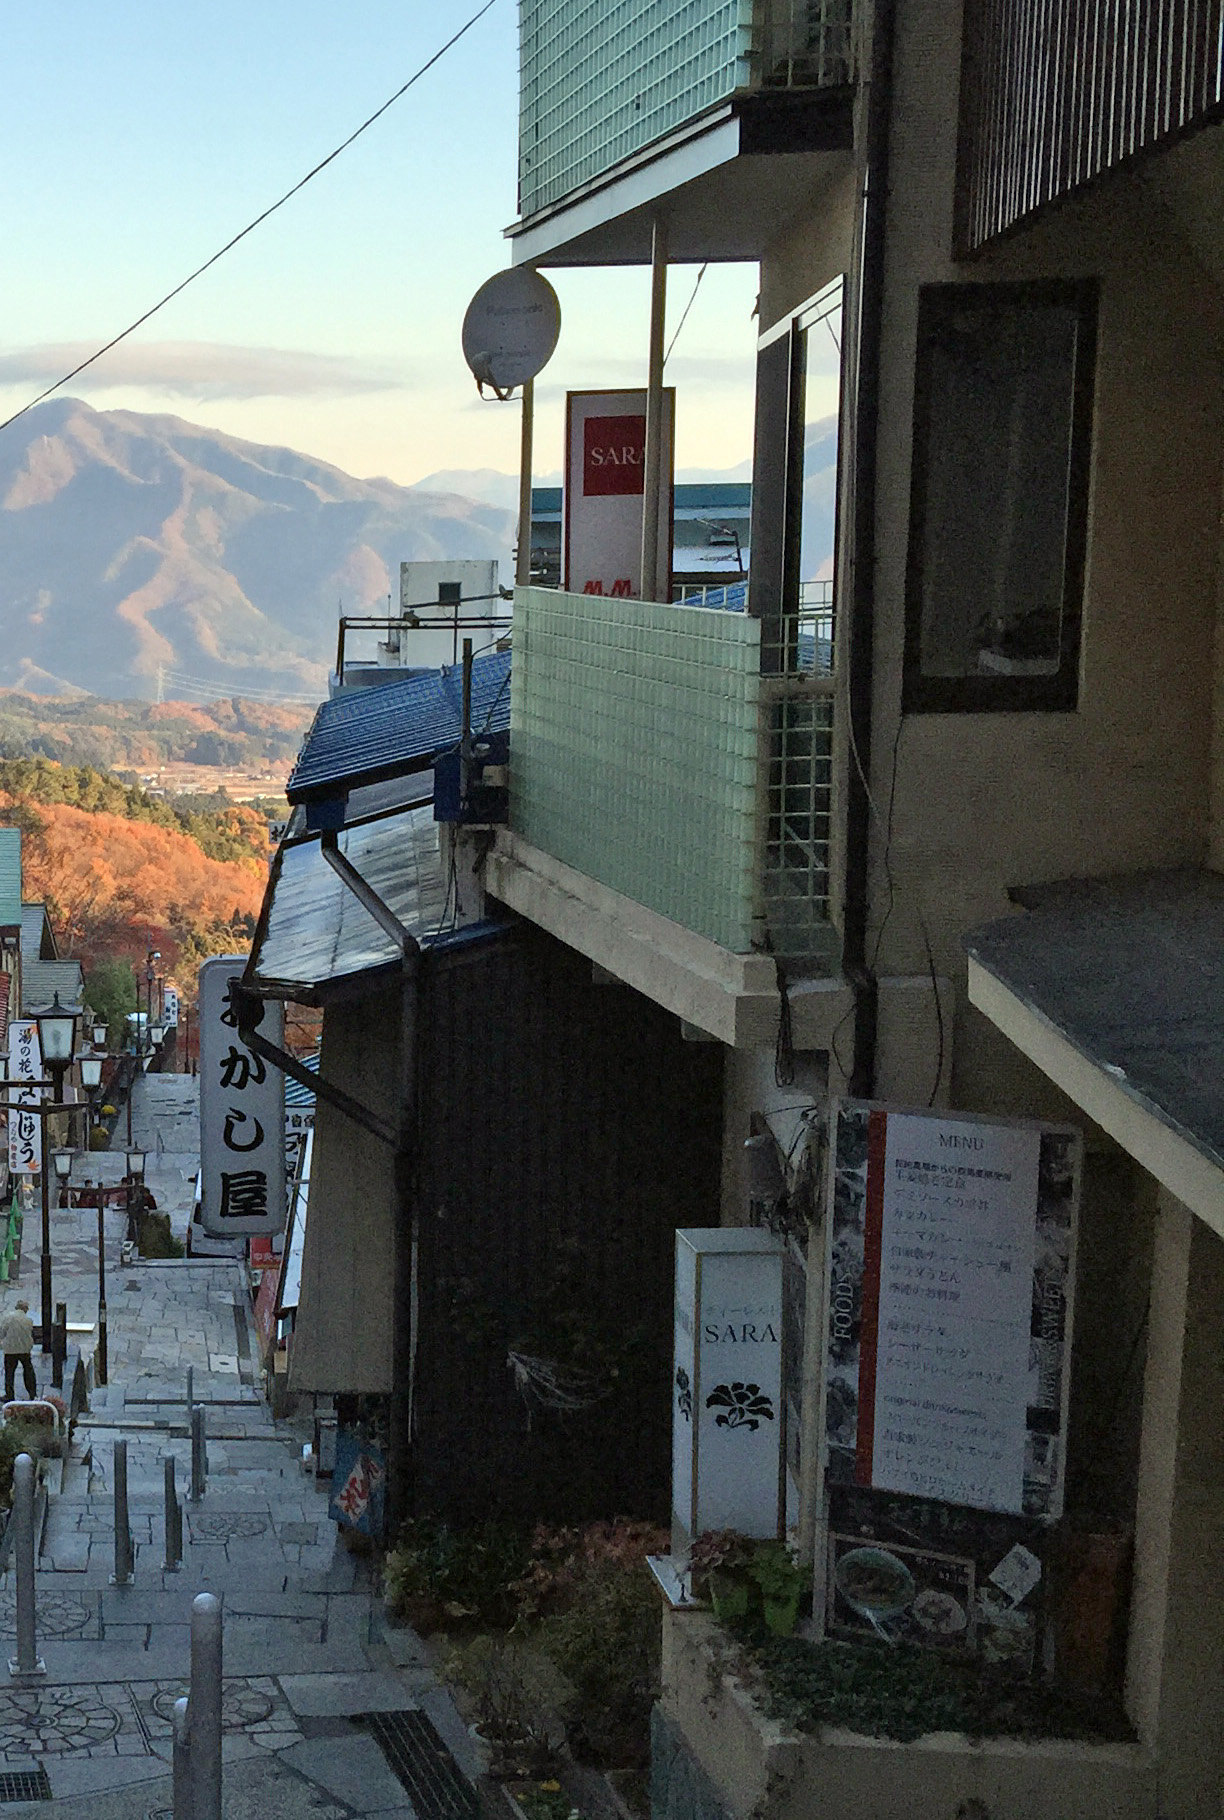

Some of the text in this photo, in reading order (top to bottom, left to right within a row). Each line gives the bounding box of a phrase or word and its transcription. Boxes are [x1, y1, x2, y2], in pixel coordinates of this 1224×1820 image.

[590, 446, 644, 466] SAR
[18, 1028, 33, 1073] 湯の花
[939, 1133, 984, 1150] MENU
[705, 1323, 778, 1343] SARA
